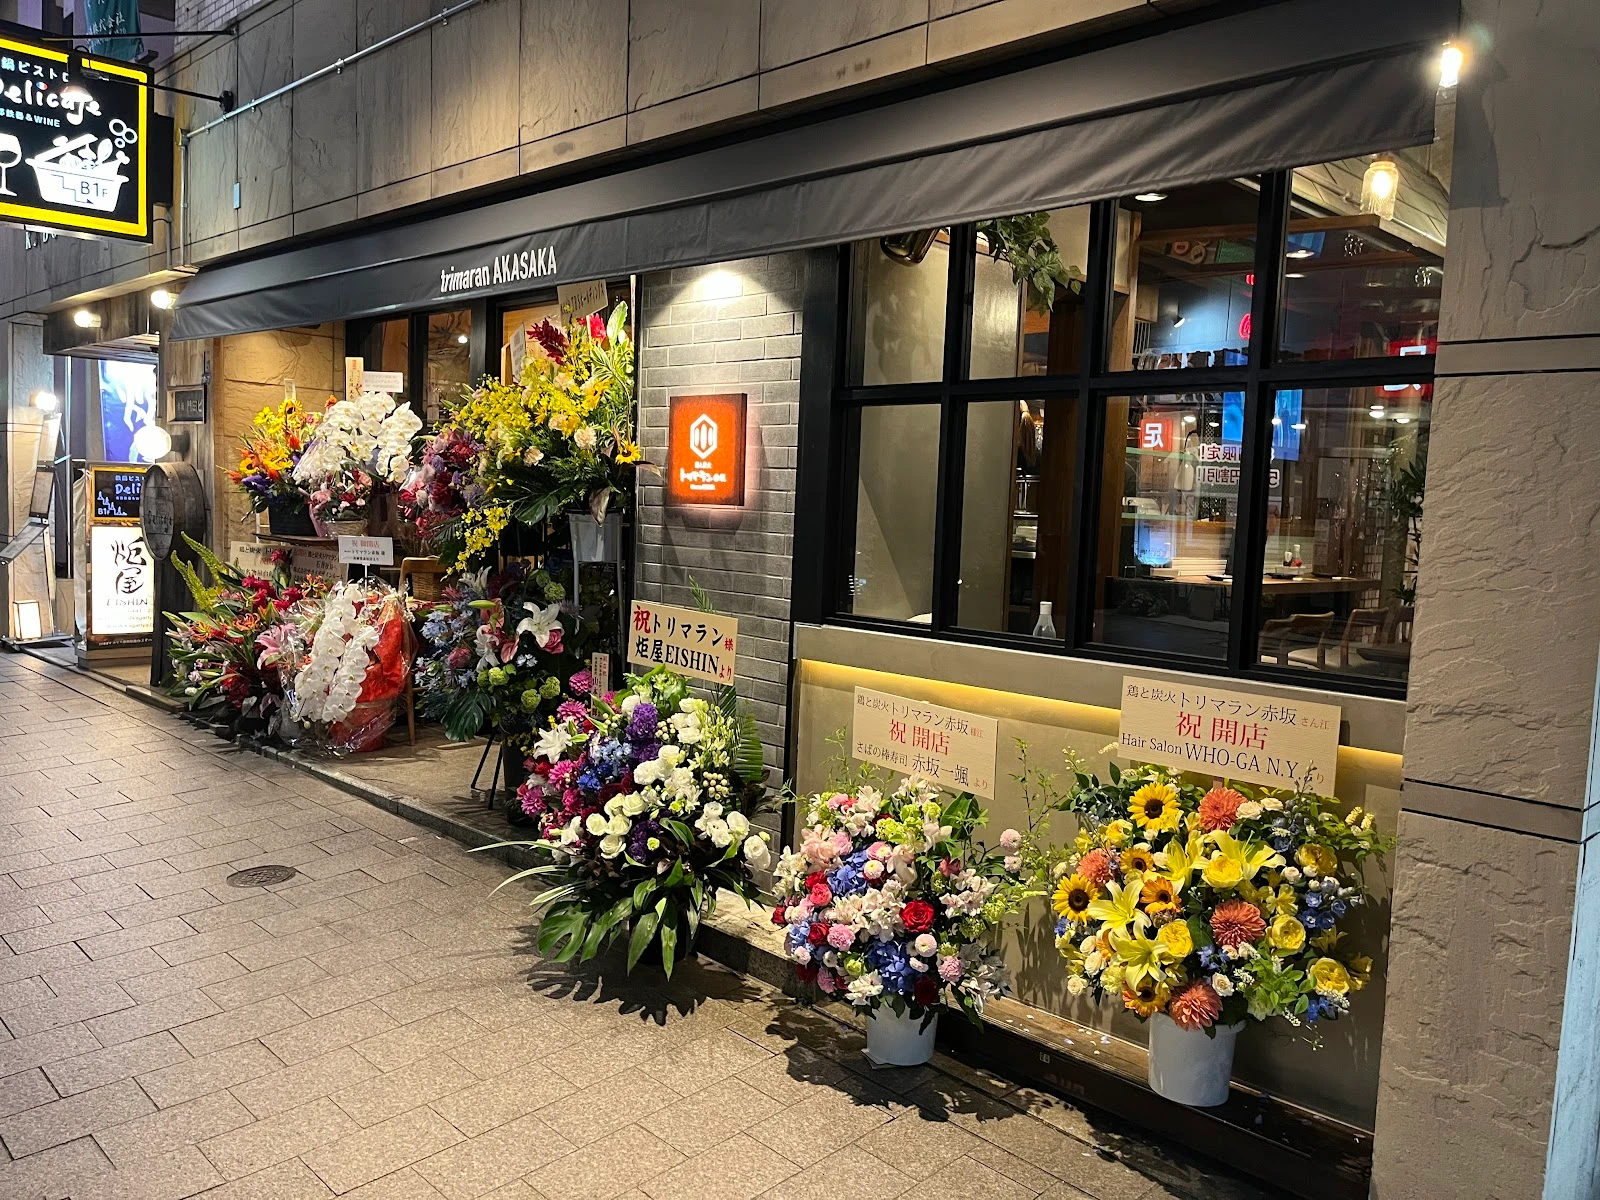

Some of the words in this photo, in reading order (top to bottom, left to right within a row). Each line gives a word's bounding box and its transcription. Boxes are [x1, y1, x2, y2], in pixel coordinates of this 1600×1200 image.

[440, 266, 490, 293] trimaran
[493, 245, 557, 285] AKASAKA
[1121, 732, 1147, 748] Hair
[1149, 737, 1182, 755] Salon
[1185, 742, 1260, 772] WHO-GA
[1266, 757, 1301, 780] N.Y.
